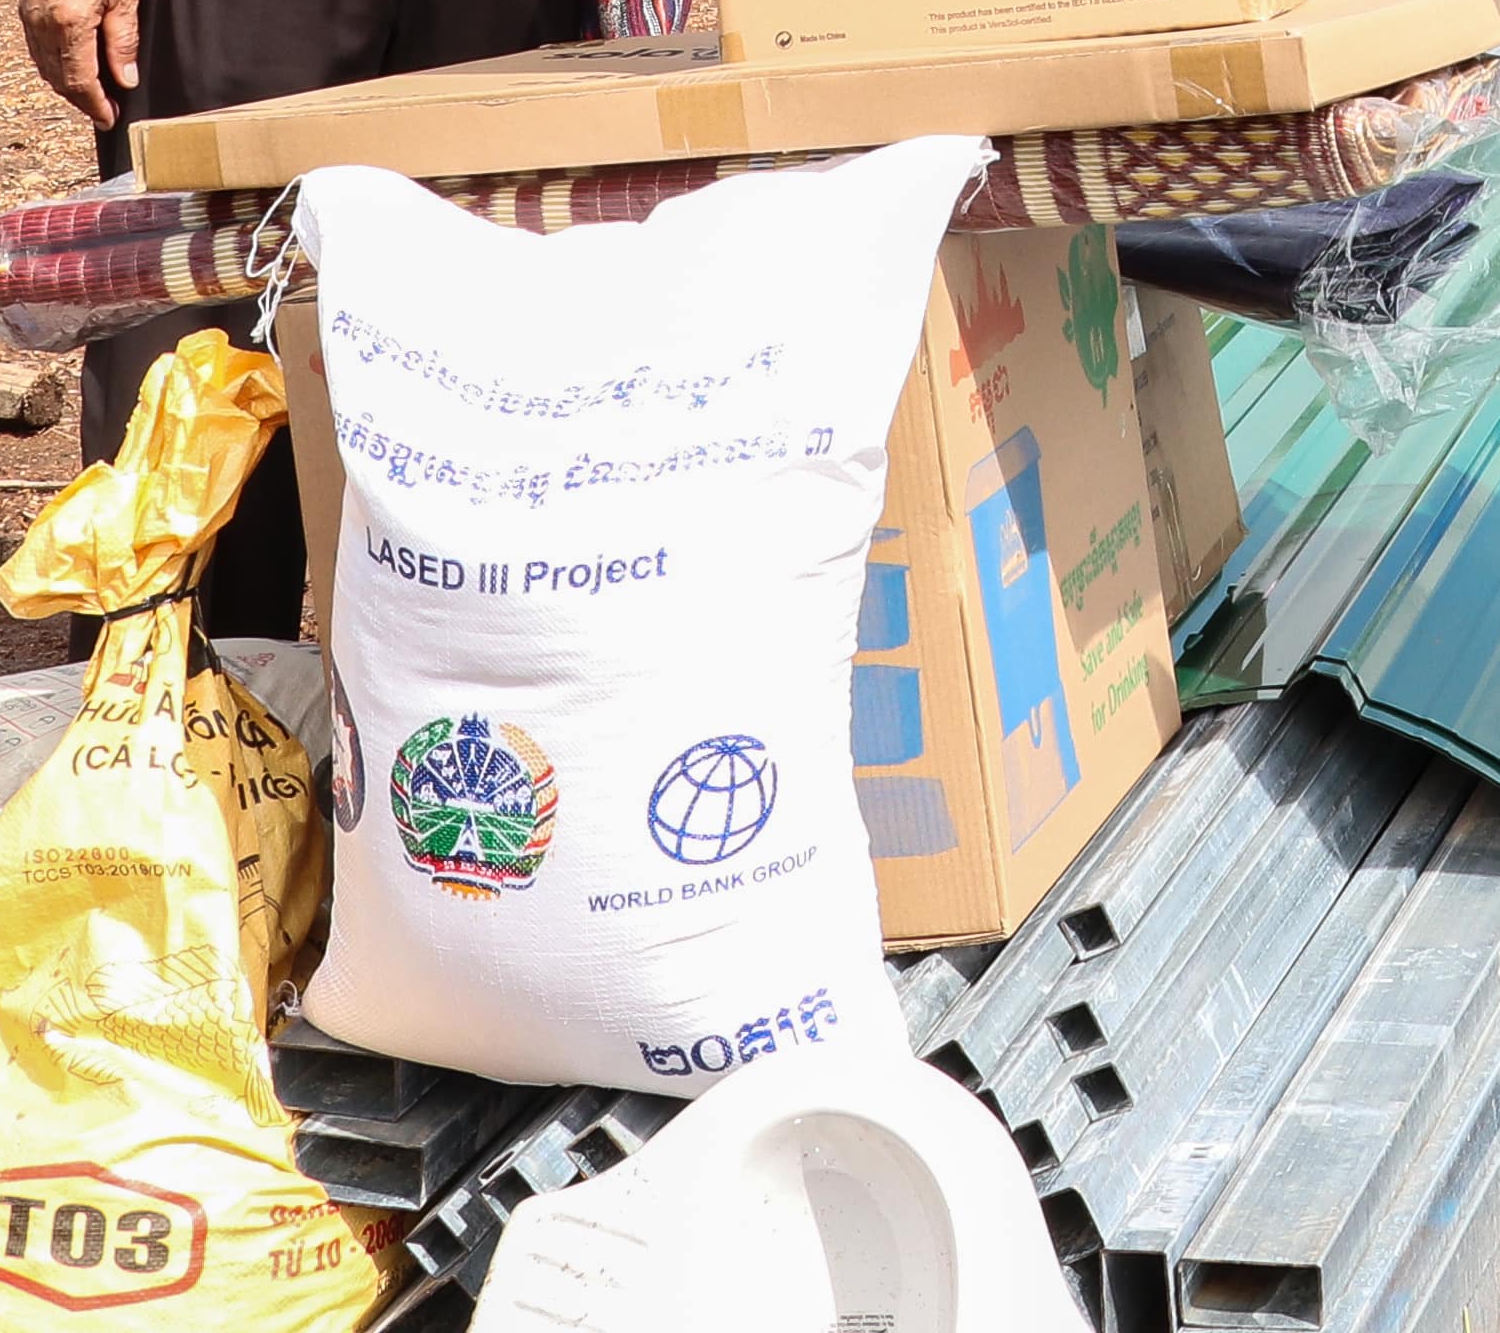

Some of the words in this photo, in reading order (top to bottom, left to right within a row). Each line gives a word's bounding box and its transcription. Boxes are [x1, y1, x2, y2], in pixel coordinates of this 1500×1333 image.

[800, 33, 819, 43] Made
[828, 32, 846, 41] China
[929, 12, 945, 21] This
[947, 9, 976, 22] product
[994, 6, 1013, 15] been
[366, 526, 464, 591] LASED
[523, 547, 668, 597] Project
[1108, 646, 1150, 716] Drinking
[22, 867, 71, 883] TCCS
[588, 886, 673, 913] WORLD
[682, 871, 745, 901] BANK
[752, 845, 818, 883] GROUP
[0, 1195, 172, 1273] T03
[314, 1238, 341, 1272] 10
